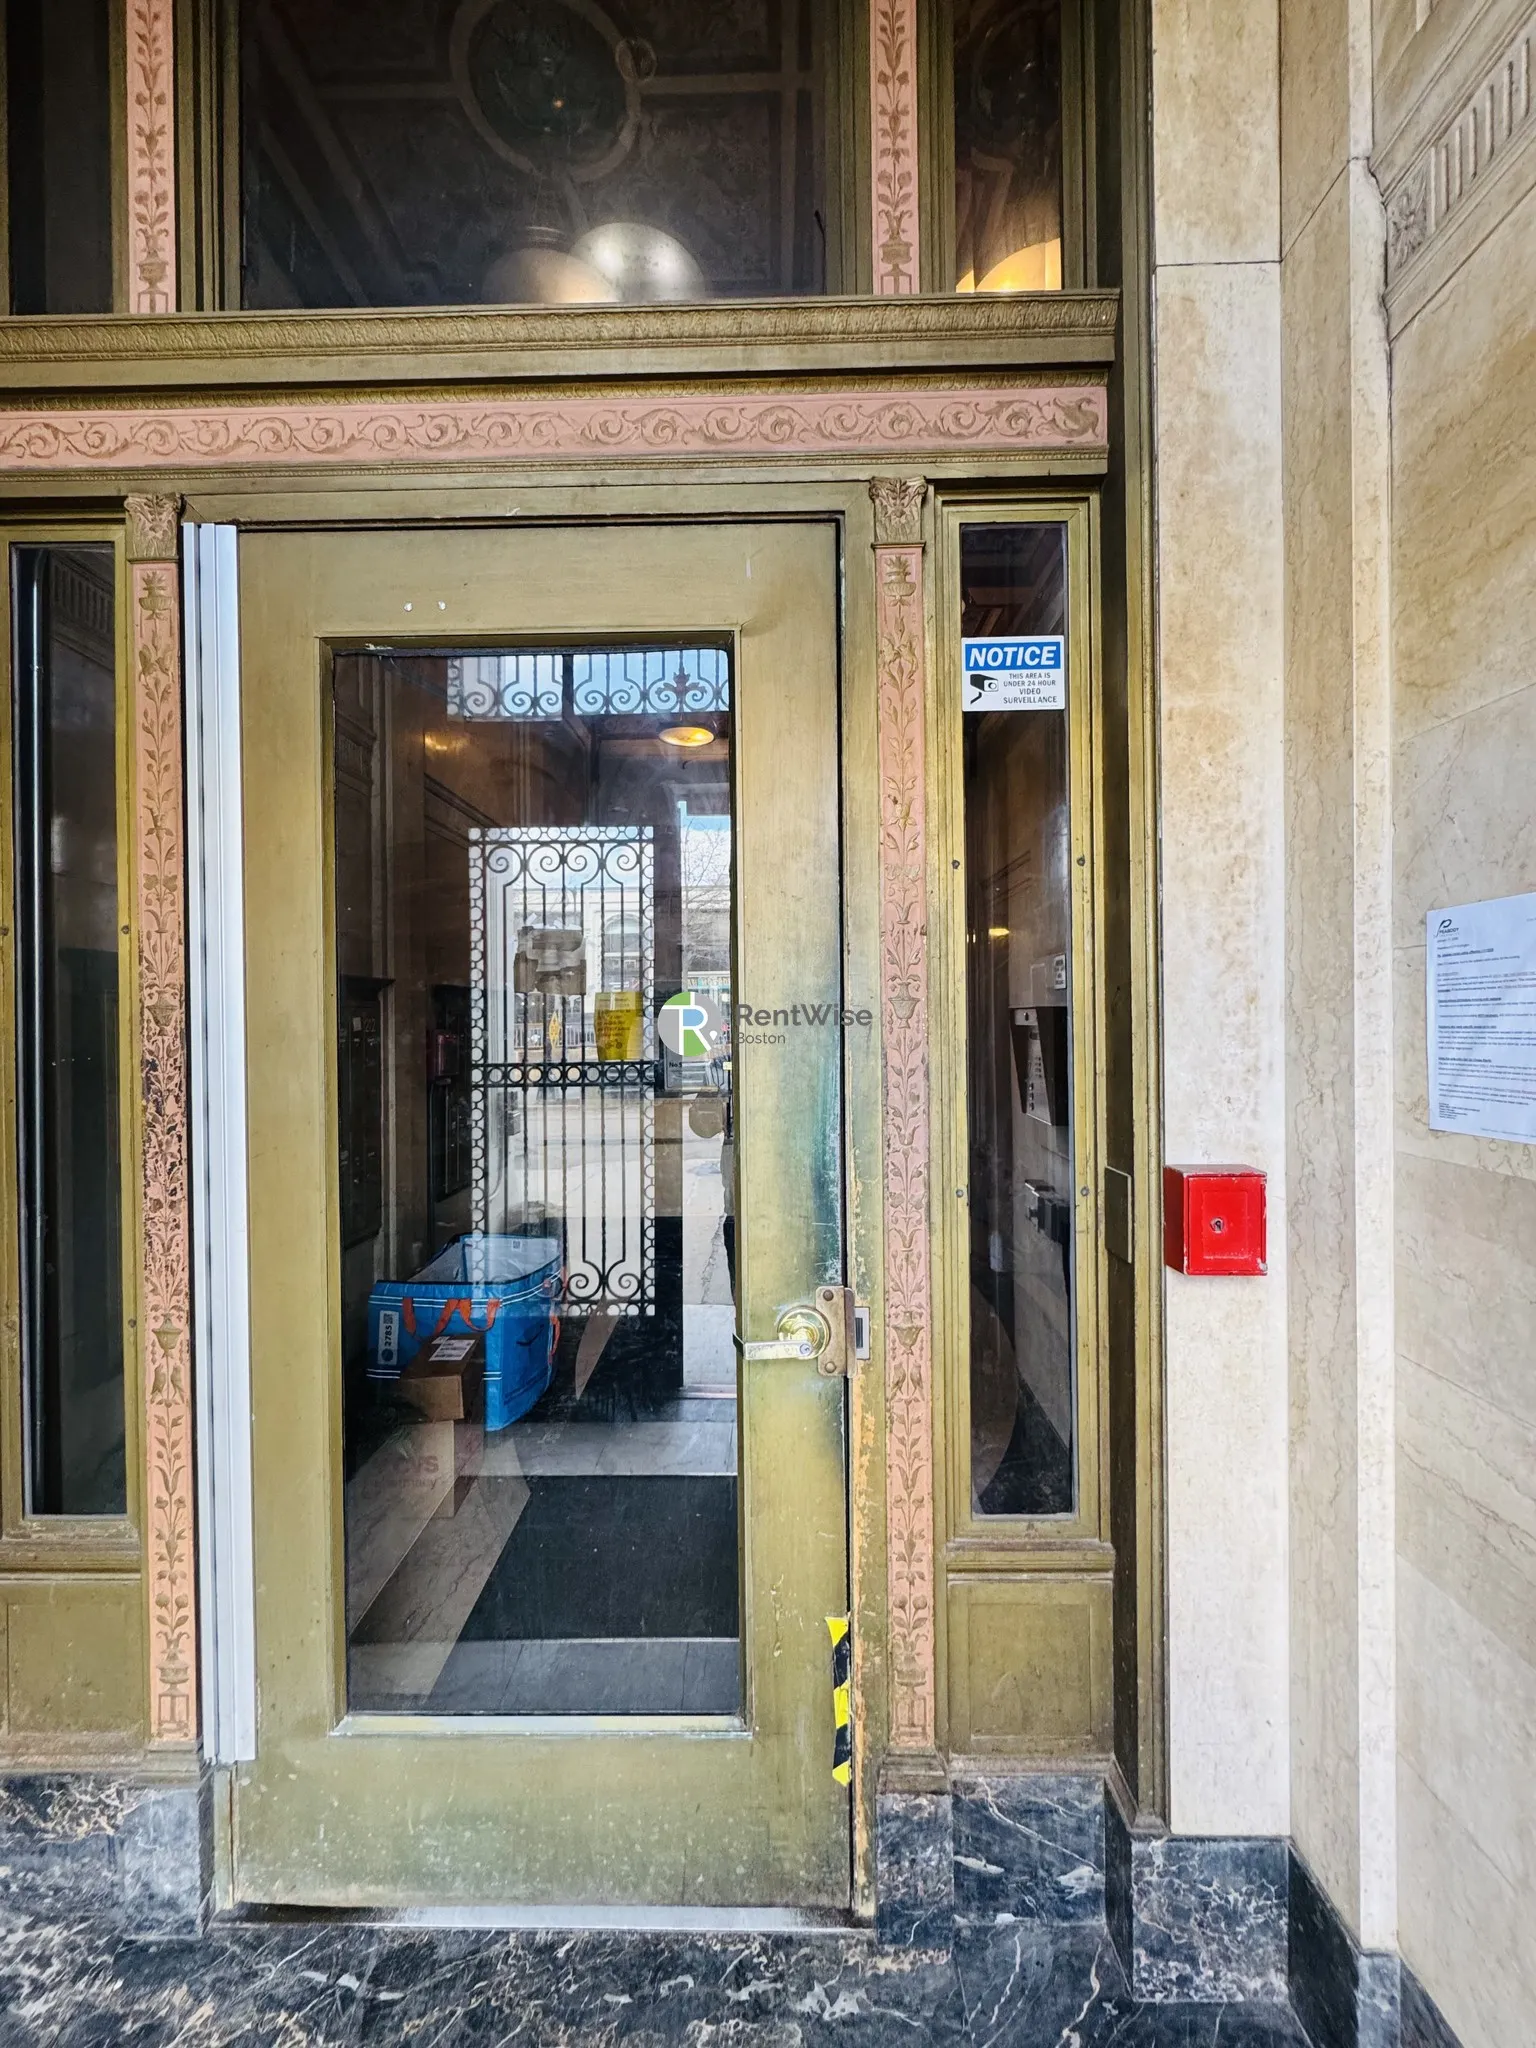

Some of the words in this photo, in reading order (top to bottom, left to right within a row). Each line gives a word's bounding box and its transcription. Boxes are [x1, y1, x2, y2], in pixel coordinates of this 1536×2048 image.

[969, 646, 1057, 667] NOTICE
[1003, 696, 1057, 704] SURVEILLANCE
[384, 1325, 393, 1347] 2785
